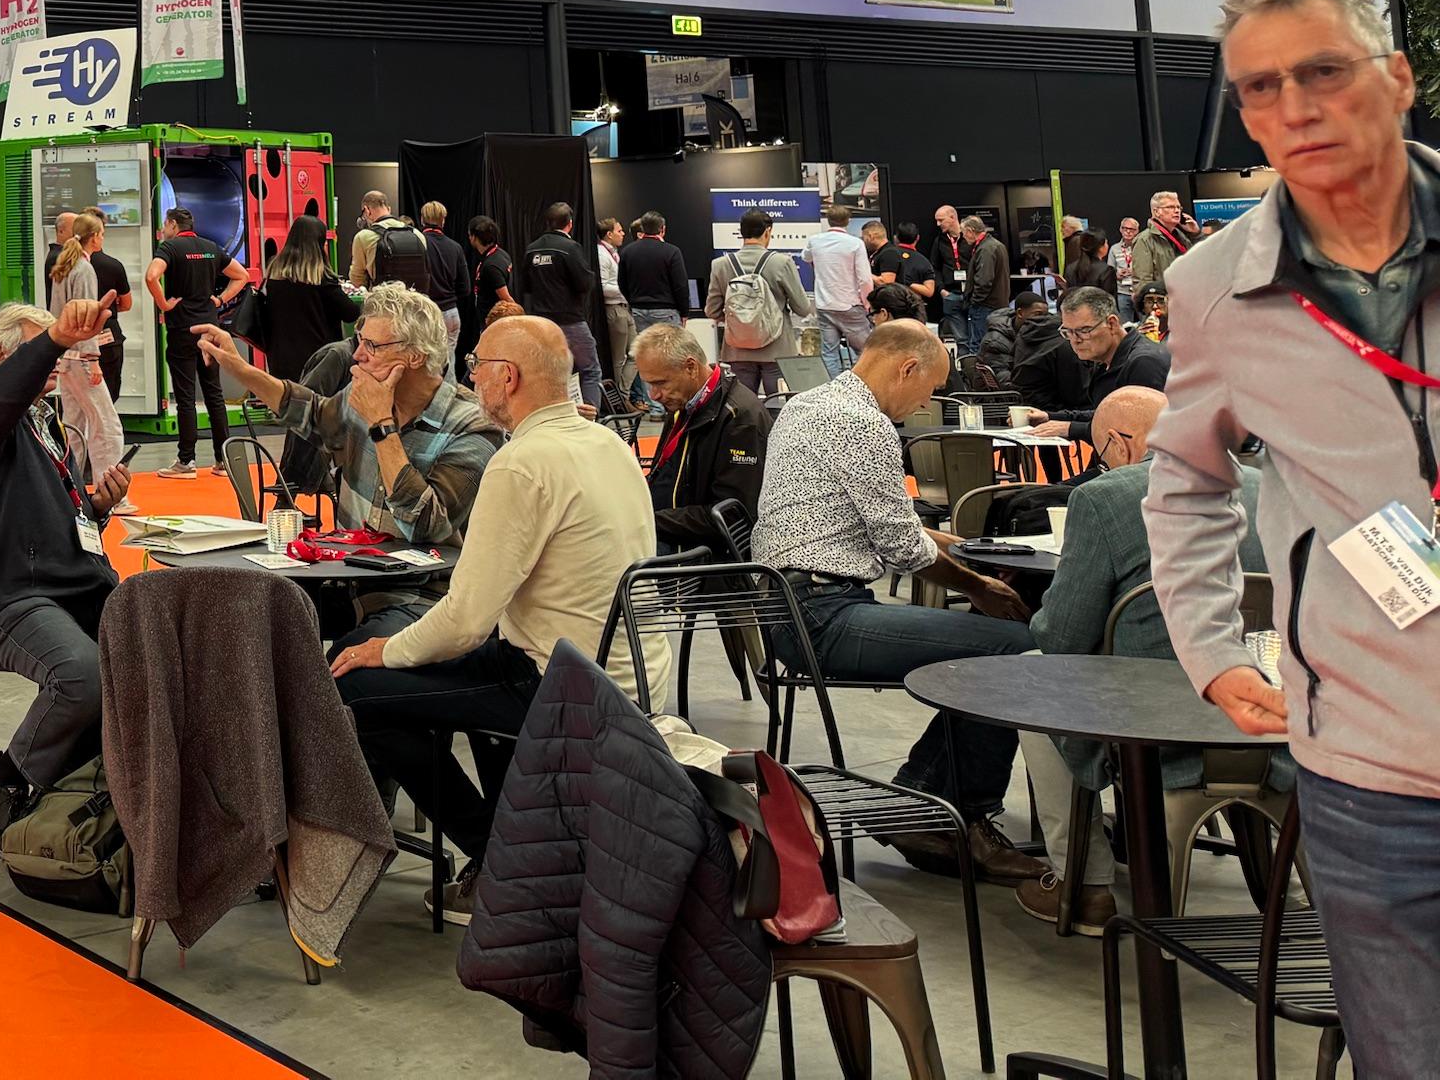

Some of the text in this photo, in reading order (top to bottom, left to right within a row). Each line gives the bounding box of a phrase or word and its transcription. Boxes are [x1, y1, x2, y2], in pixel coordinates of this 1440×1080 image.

[72, 45, 118, 98] Hy
[675, 71, 700, 84] Hal 6
[12, 107, 117, 128] STREAM
[731, 198, 800, 208] Think different.
[1368, 526, 1396, 557] M.T.S.
[1396, 556, 1414, 576] van
[1413, 575, 1433, 598] Dijk
[1398, 570, 1413, 589] VAN
[1411, 587, 1431, 606] DIJK
